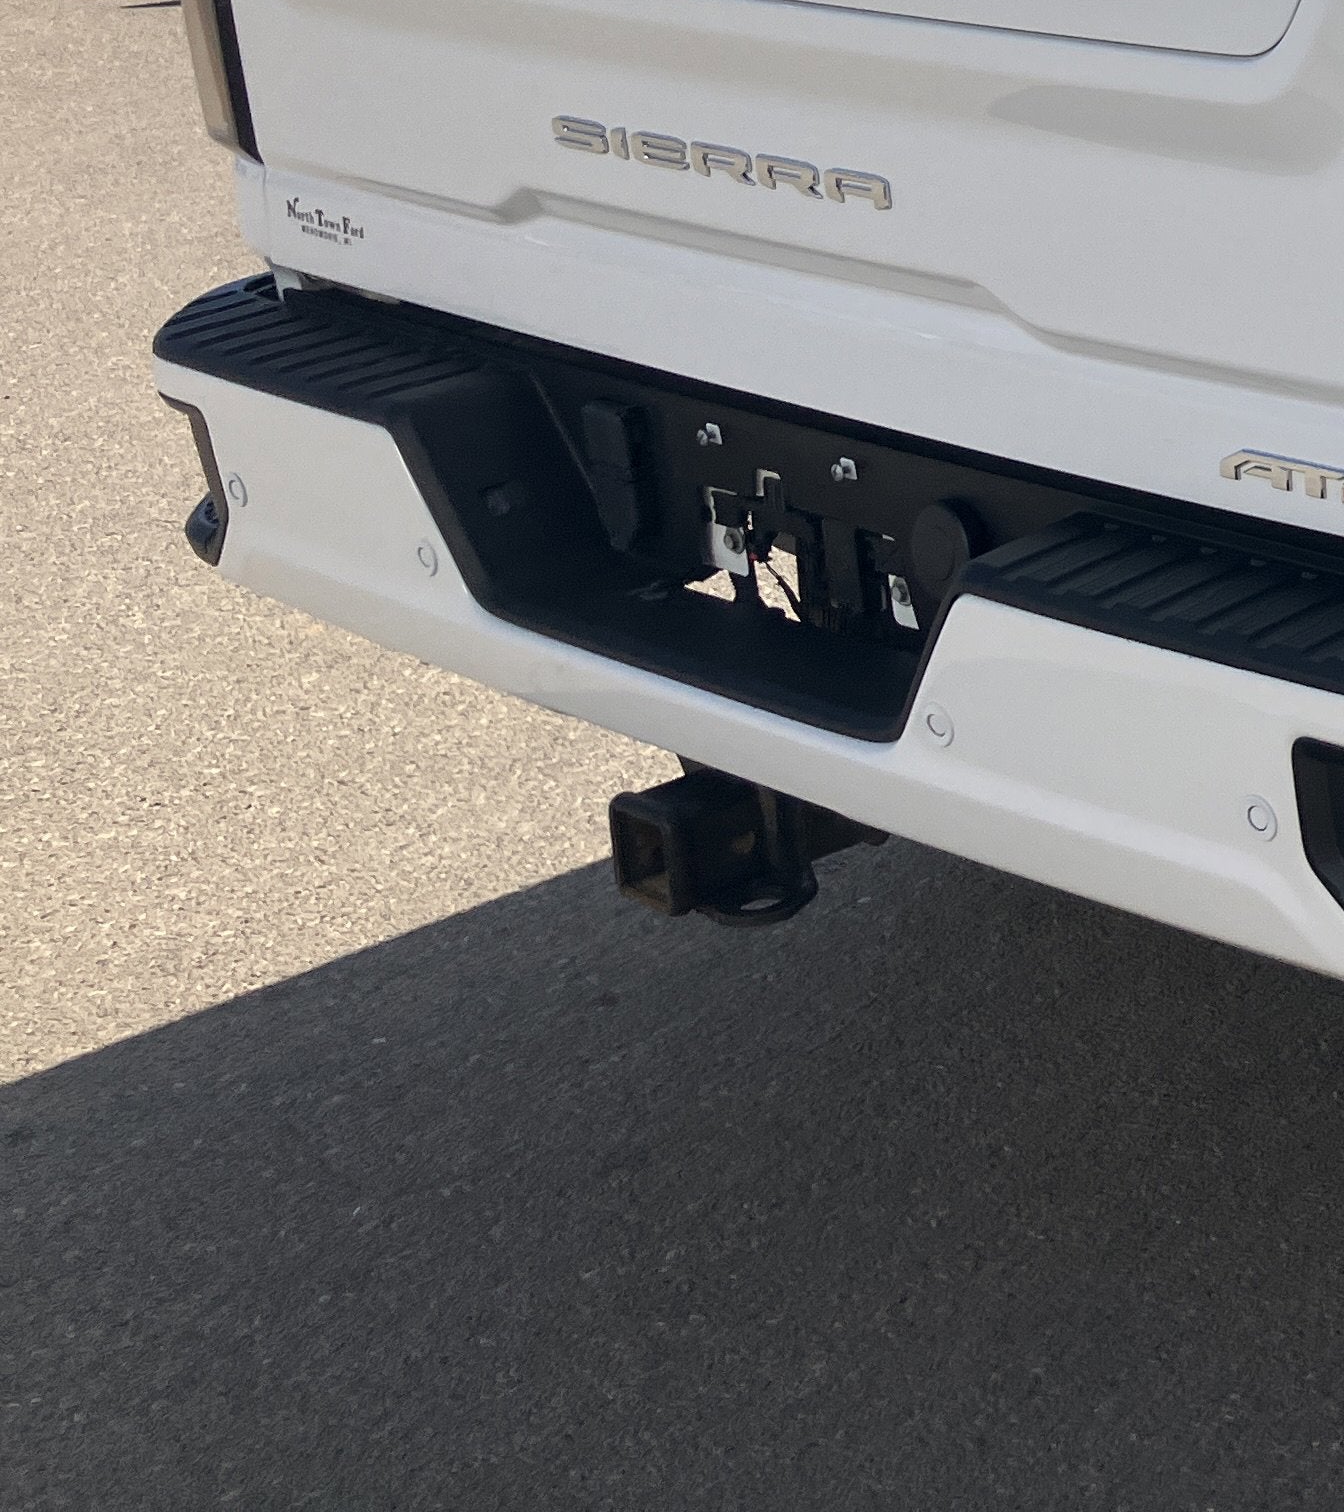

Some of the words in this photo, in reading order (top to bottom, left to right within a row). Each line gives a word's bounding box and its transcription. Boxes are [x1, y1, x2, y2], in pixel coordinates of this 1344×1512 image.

[551, 115, 893, 210] SIERRA
[286, 197, 315, 224] North
[314, 208, 341, 232] Town
[342, 216, 364, 239] Ford
